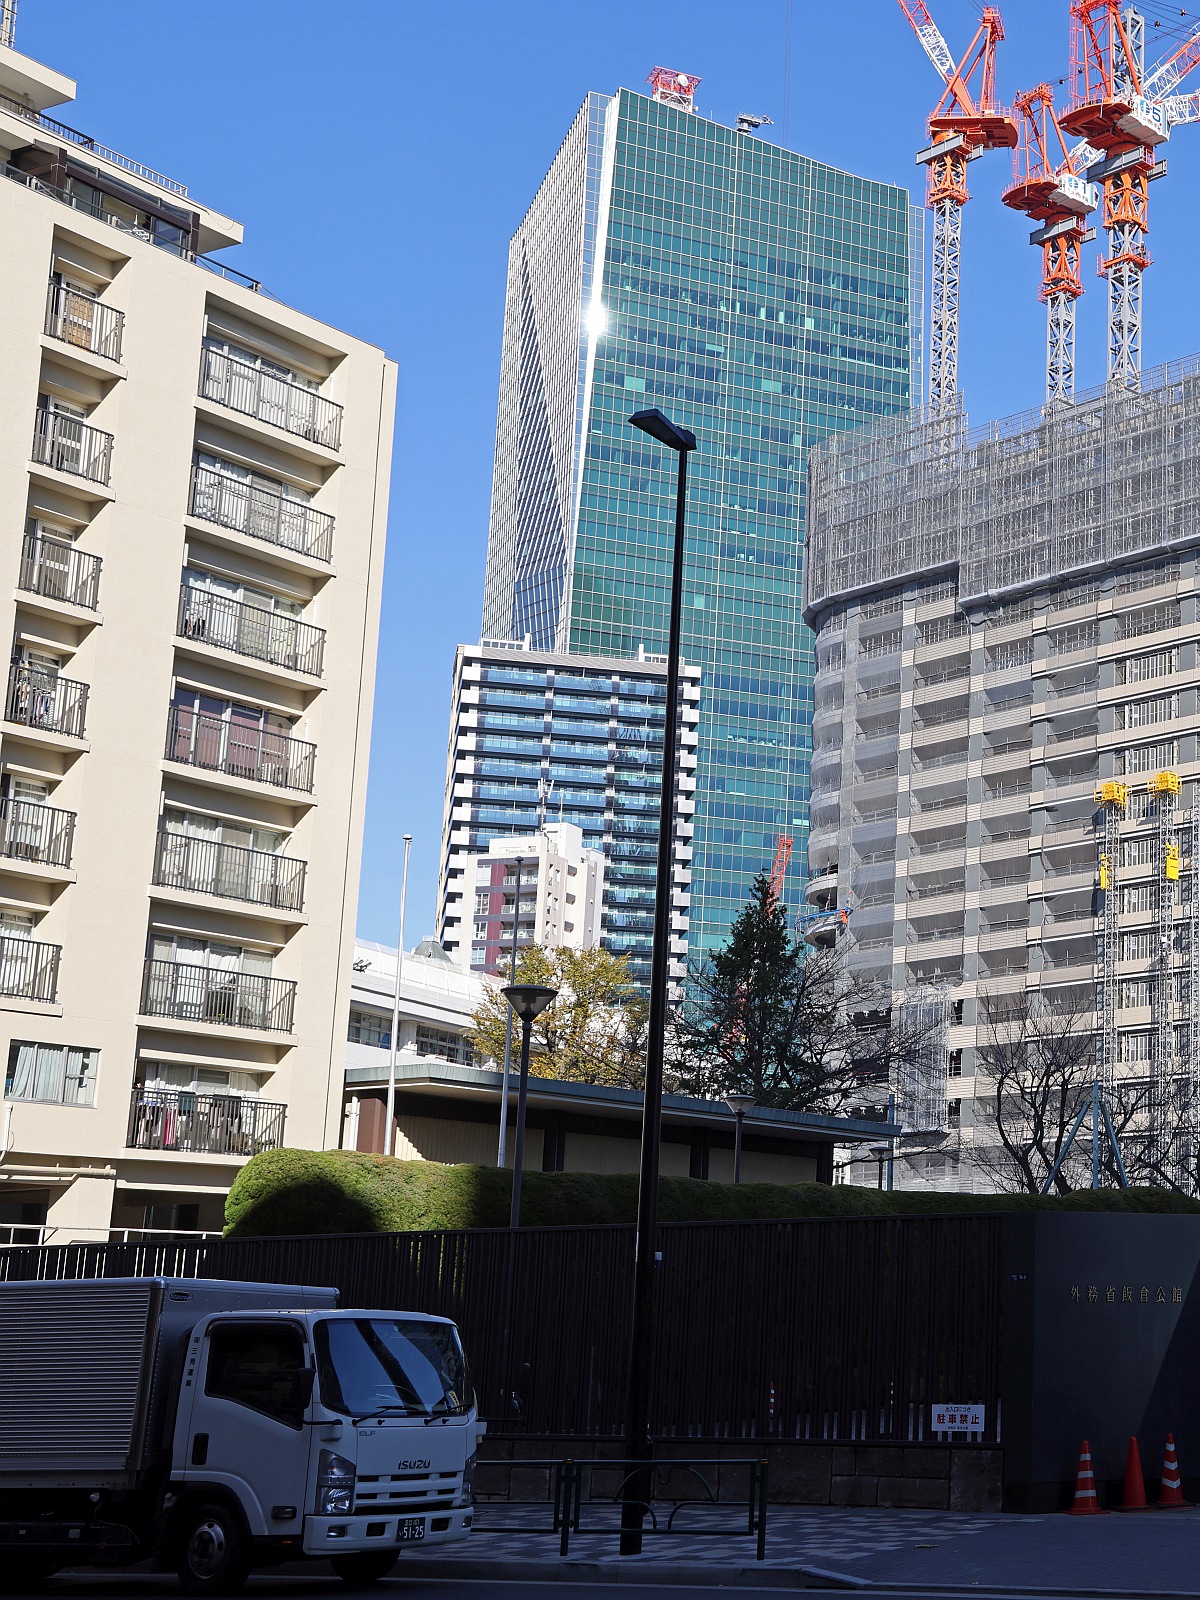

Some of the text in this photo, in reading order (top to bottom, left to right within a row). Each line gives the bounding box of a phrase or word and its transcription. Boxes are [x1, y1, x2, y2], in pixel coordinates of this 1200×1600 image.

[1152, 106, 1161, 123] 5
[1070, 1285, 1183, 1303] 外務省飯倉公館
[936, 1413, 980, 1425] 駐車禁止
[397, 1459, 431, 1470] ISUZU
